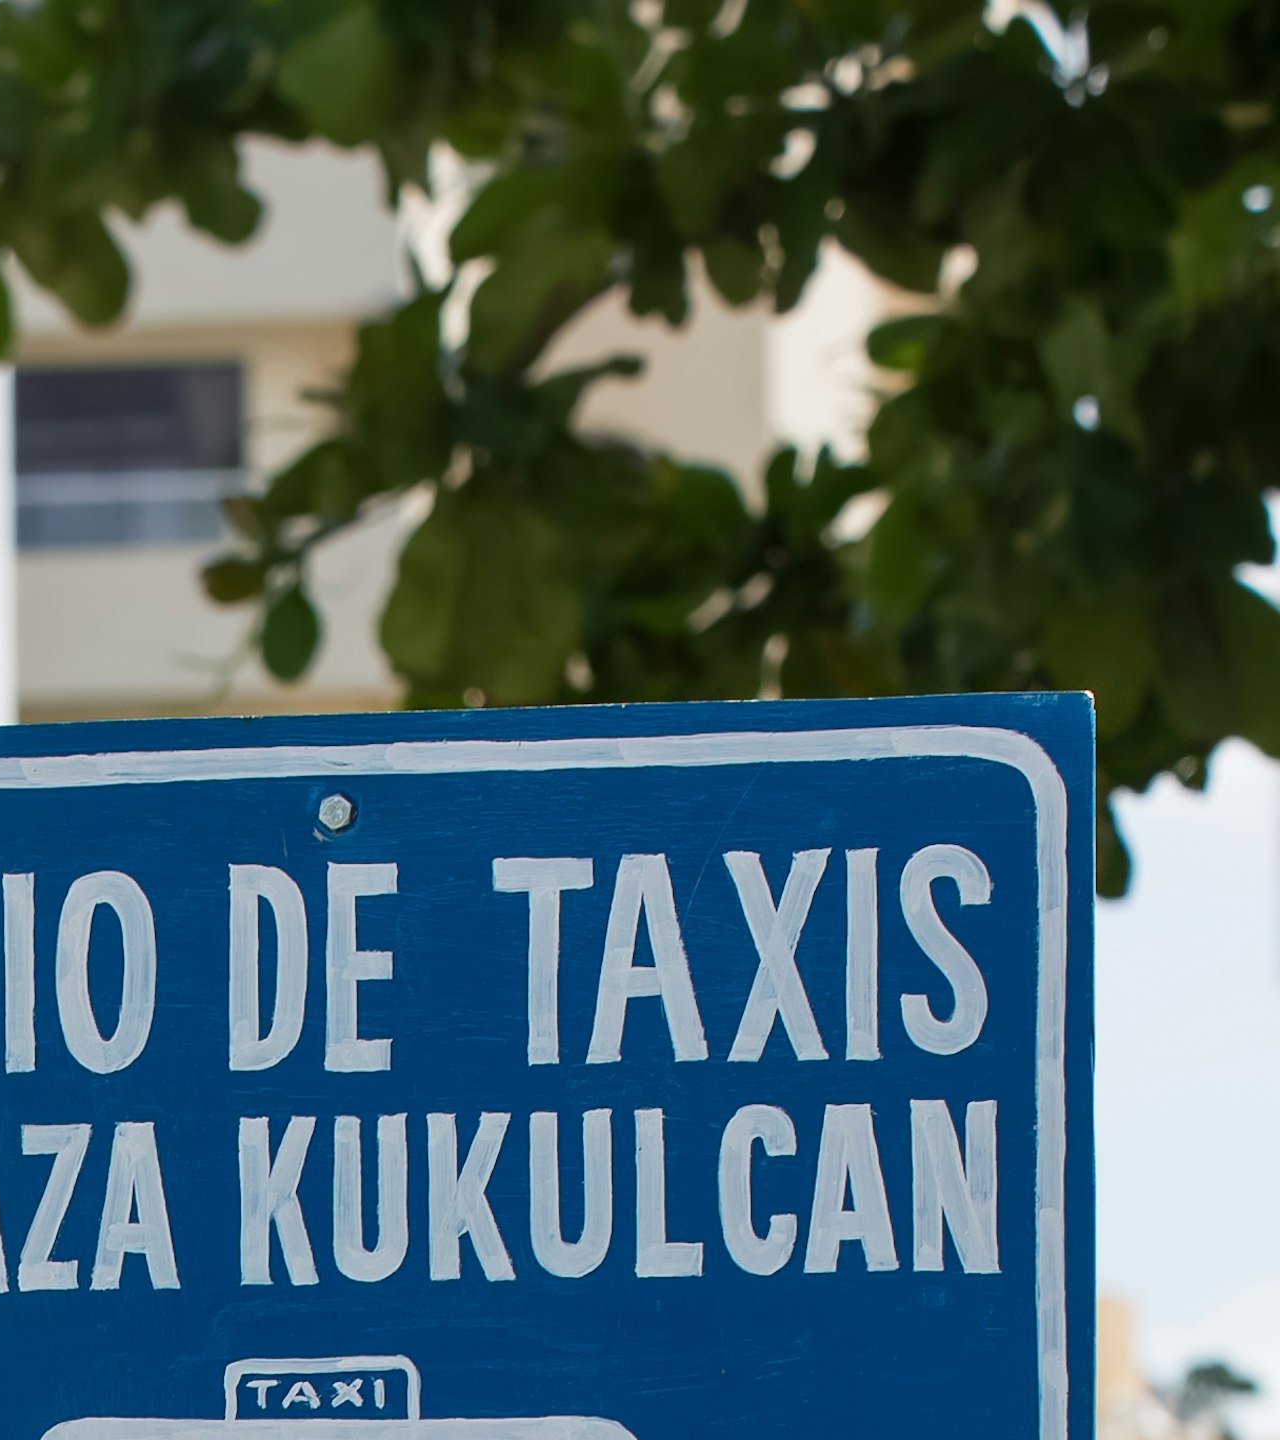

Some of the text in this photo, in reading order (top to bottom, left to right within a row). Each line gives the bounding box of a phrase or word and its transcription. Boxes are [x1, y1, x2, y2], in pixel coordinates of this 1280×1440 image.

[227, 860, 400, 1074] DE
[491, 842, 993, 1066] TAXIS
[238, 1099, 1001, 1287] KUKULCAN
[245, 1377, 386, 1410] TAXI
